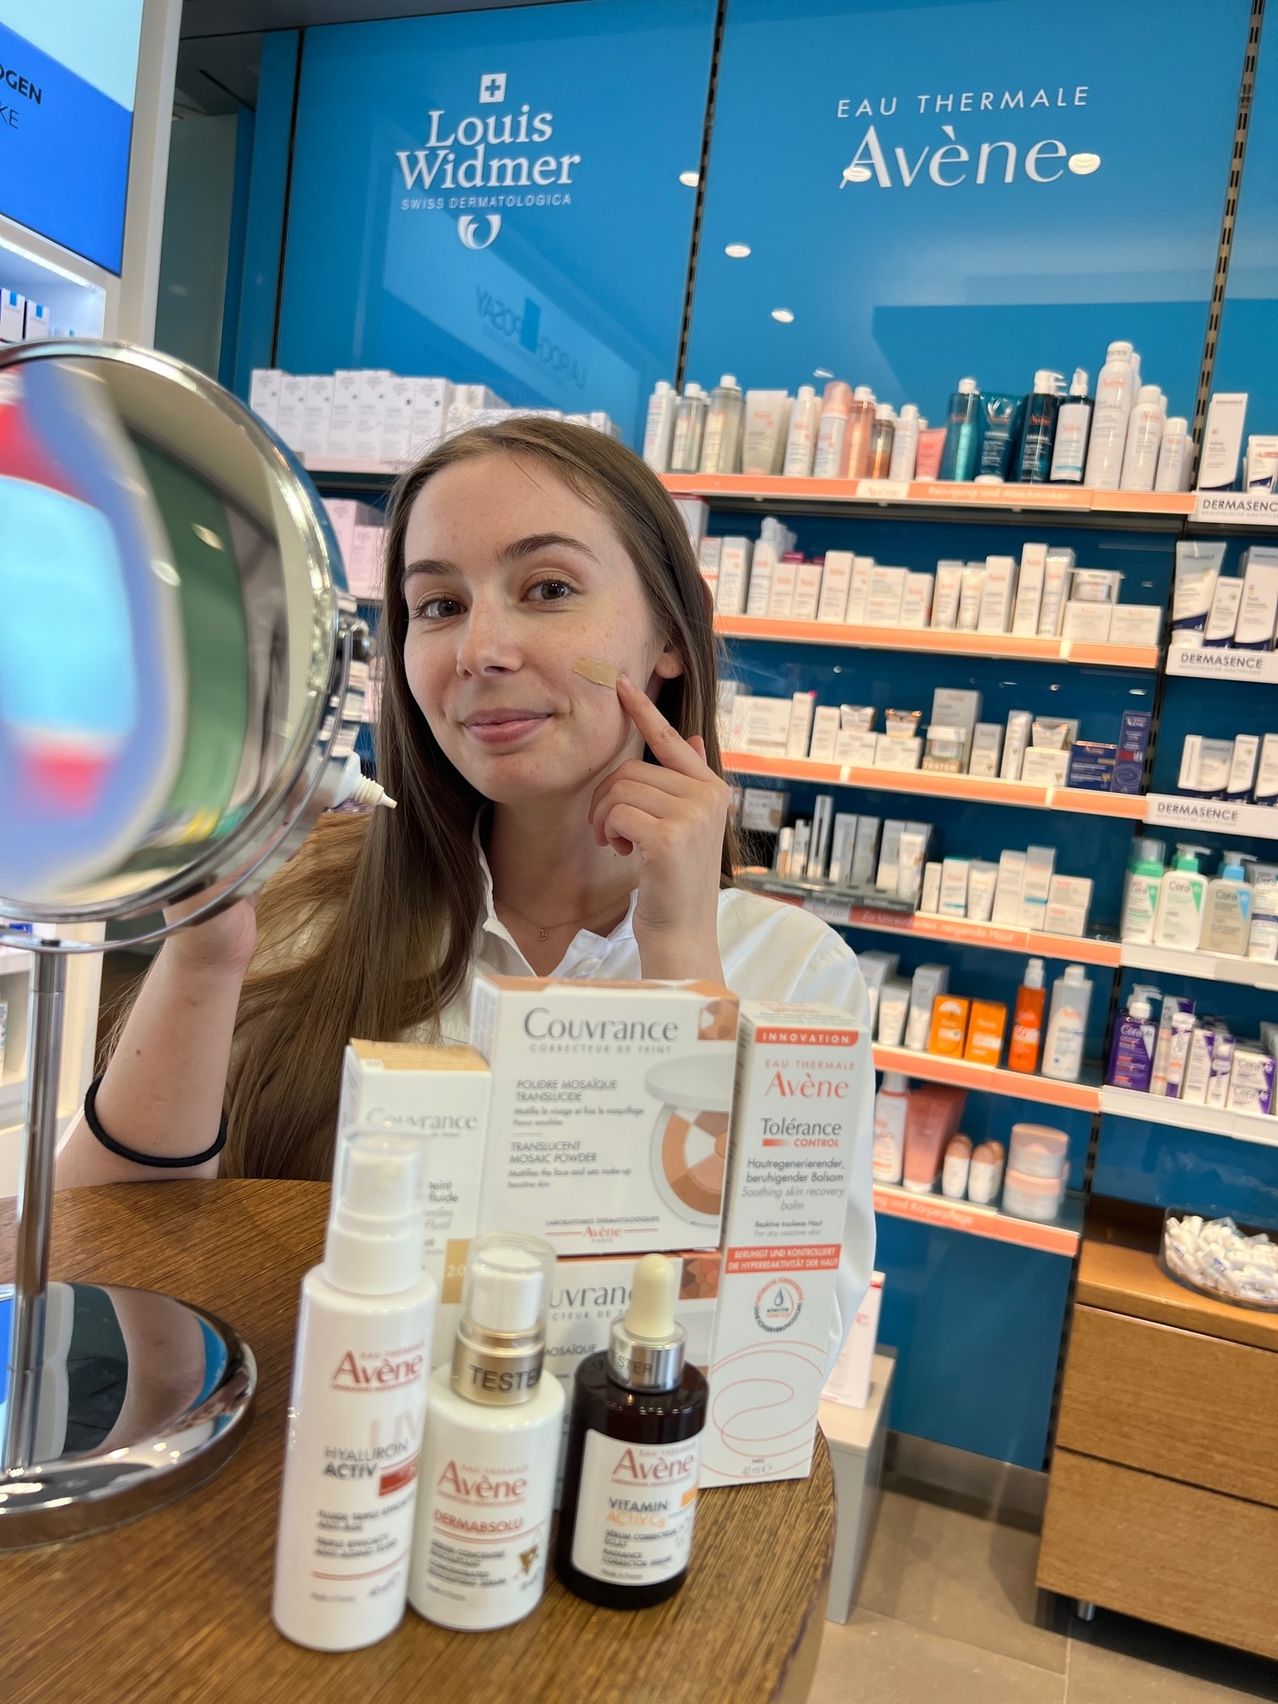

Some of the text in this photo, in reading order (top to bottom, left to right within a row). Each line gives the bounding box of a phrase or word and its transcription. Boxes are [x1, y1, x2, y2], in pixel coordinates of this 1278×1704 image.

[837, 86, 1089, 118] EAU THERMALE
[425, 104, 553, 147] Louis
[839, 124, 1067, 189] Avène
[395, 143, 582, 191] Widmer
[400, 193, 572, 211] SWISS DERMATOLOGICA
[1180, 652, 1264, 669] DERMASENCE
[1157, 801, 1240, 821] DERMASENCE
[523, 1007, 679, 1042] Couvrance
[762, 1031, 850, 1044] INNOVATION
[530, 1042, 672, 1055] CORRECTEUR DE TEINT
[764, 1059, 855, 1071] EAU THERMALE
[516, 1077, 617, 1090] POUDRE MOSAÏQUE
[763, 1070, 849, 1099] Avène
[515, 1091, 583, 1102] TRANSLUCIDE
[366, 1107, 479, 1130] Couvrance
[760, 1116, 842, 1136] Tolérance
[511, 1140, 581, 1151] TRANSLUCENT
[793, 1138, 840, 1148] CONTROL
[509, 1152, 598, 1164] MOSAIC POWDER
[747, 1157, 845, 1170] Hautregenerierender,
[746, 1171, 844, 1185] beruhigender Balsam
[741, 1185, 846, 1199] Soothing skin recovery
[779, 1199, 805, 1211] balm
[582, 1226, 622, 1238] Avène
[770, 1248, 786, 1258] UND
[787, 1246, 836, 1257] KONTROLLIERT
[805, 1257, 818, 1267] DER
[820, 1256, 838, 1267] HAUT
[597, 1310, 611, 1320] DE
[333, 1350, 424, 1384] Avène
[324, 1438, 409, 1462] HYALURON
[324, 1461, 378, 1478] ACTIV
[612, 1447, 694, 1480] Avène
[438, 1459, 528, 1499] Avène
[608, 1496, 669, 1513] VITAMIN
[433, 1507, 524, 1534] DERMABSOLU
